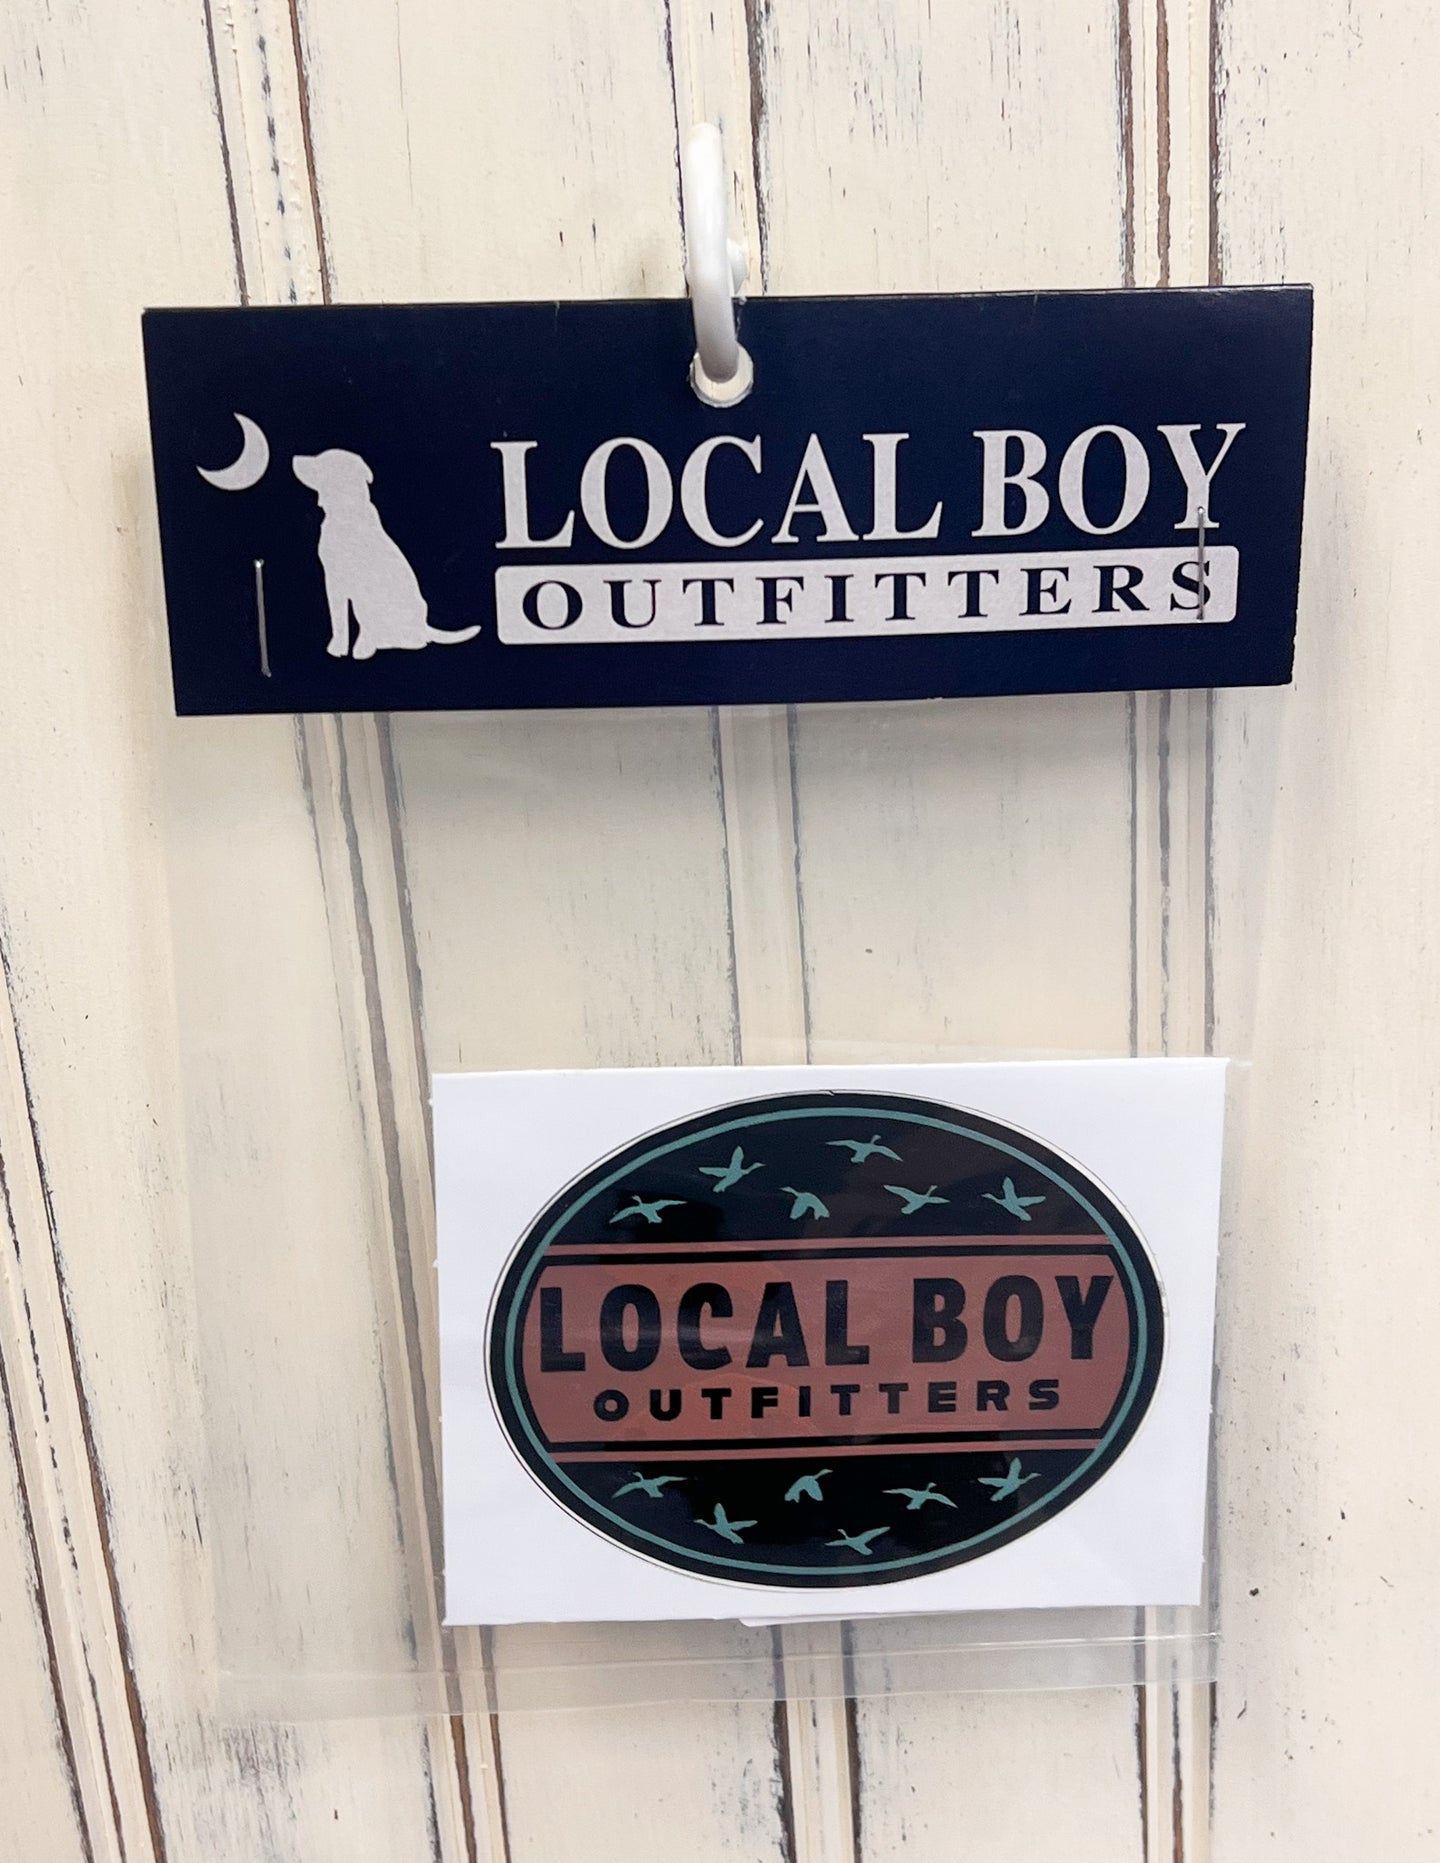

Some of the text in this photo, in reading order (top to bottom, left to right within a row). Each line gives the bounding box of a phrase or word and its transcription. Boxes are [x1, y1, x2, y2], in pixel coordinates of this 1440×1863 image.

[493, 422, 1246, 551] LOCAL BOY
[523, 559, 1215, 631] OUTFITTERS
[539, 1273, 1115, 1374] LOCAL BOY
[593, 1378, 1060, 1422] OUTFITTERS
